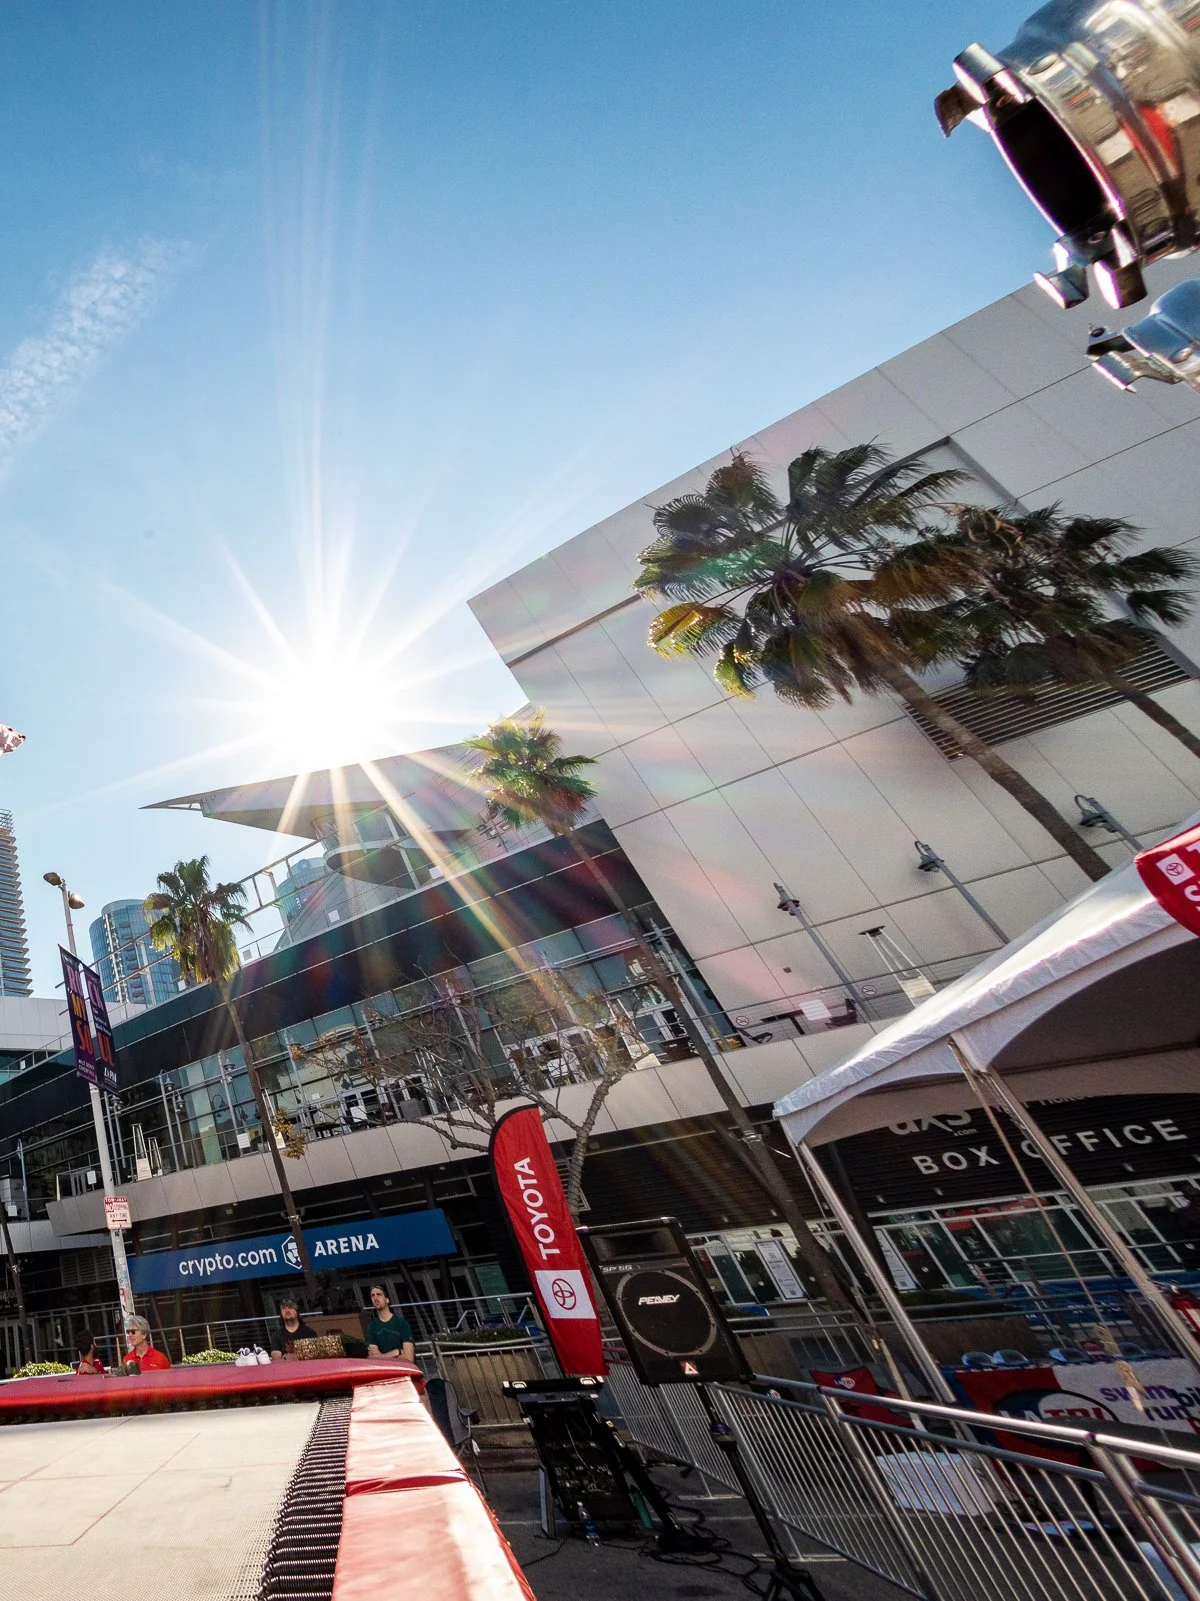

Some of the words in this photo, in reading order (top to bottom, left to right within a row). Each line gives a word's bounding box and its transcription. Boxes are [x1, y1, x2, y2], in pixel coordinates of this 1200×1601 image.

[912, 1146, 999, 1175] BOX
[1020, 1119, 1188, 1159] OFFICE
[514, 1157, 560, 1260] TOYOTA
[179, 1248, 277, 1276] crypto.com
[314, 1233, 379, 1257] ARENA
[638, 1295, 680, 1305] PEAVEY
[1099, 1385, 1173, 1402] swm
[1143, 1405, 1192, 1421] run
